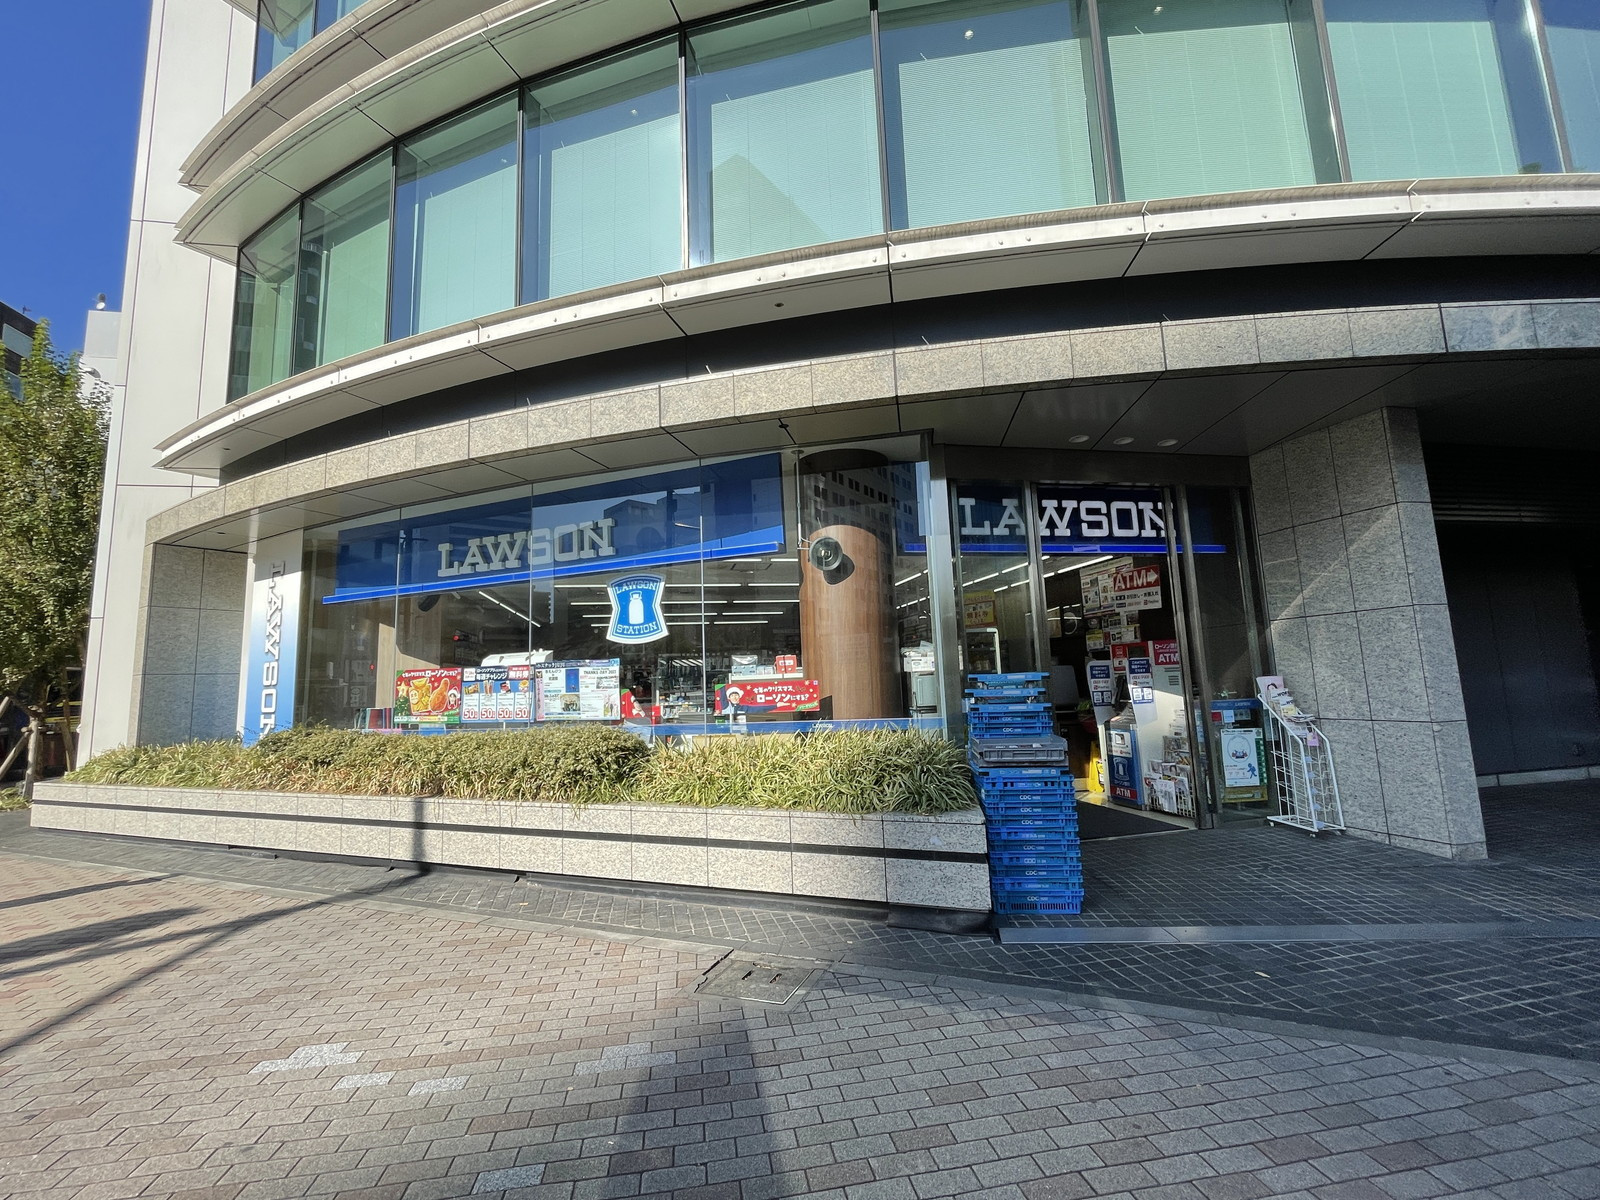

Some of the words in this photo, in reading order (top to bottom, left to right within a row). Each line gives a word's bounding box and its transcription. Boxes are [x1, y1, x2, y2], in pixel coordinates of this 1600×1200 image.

[958, 497, 1175, 538] LAWSON
[437, 517, 616, 577] LAWSON
[1114, 569, 1146, 591] ATM
[615, 580, 657, 594] LAWSON
[616, 621, 657, 634] STATION
[1158, 653, 1178, 663] ATM
[753, 685, 795, 693] 今年のクリスマス、
[1116, 788, 1130, 797] ATM
